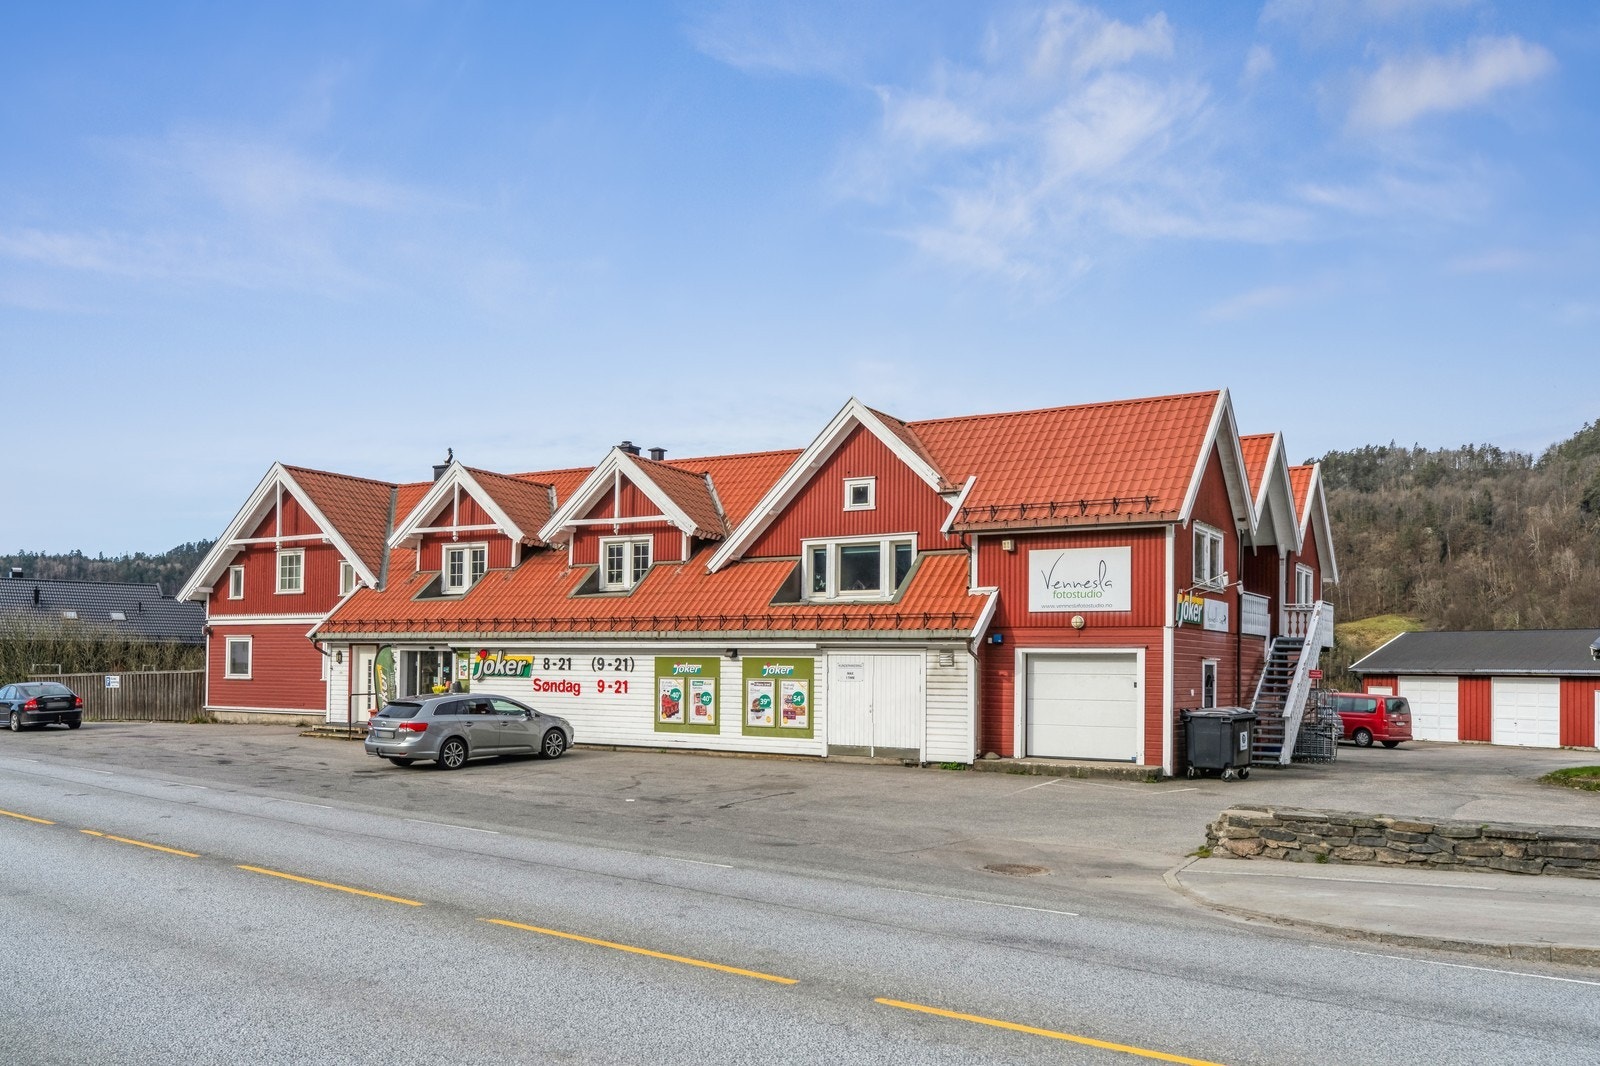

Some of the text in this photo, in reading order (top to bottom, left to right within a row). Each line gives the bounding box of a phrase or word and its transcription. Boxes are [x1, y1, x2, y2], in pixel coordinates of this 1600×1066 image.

[1041, 552, 1113, 592] Vennesla
[1053, 590, 1103, 599] fotostudio
[472, 649, 530, 680] joker
[533, 678, 581, 696] Søndag
